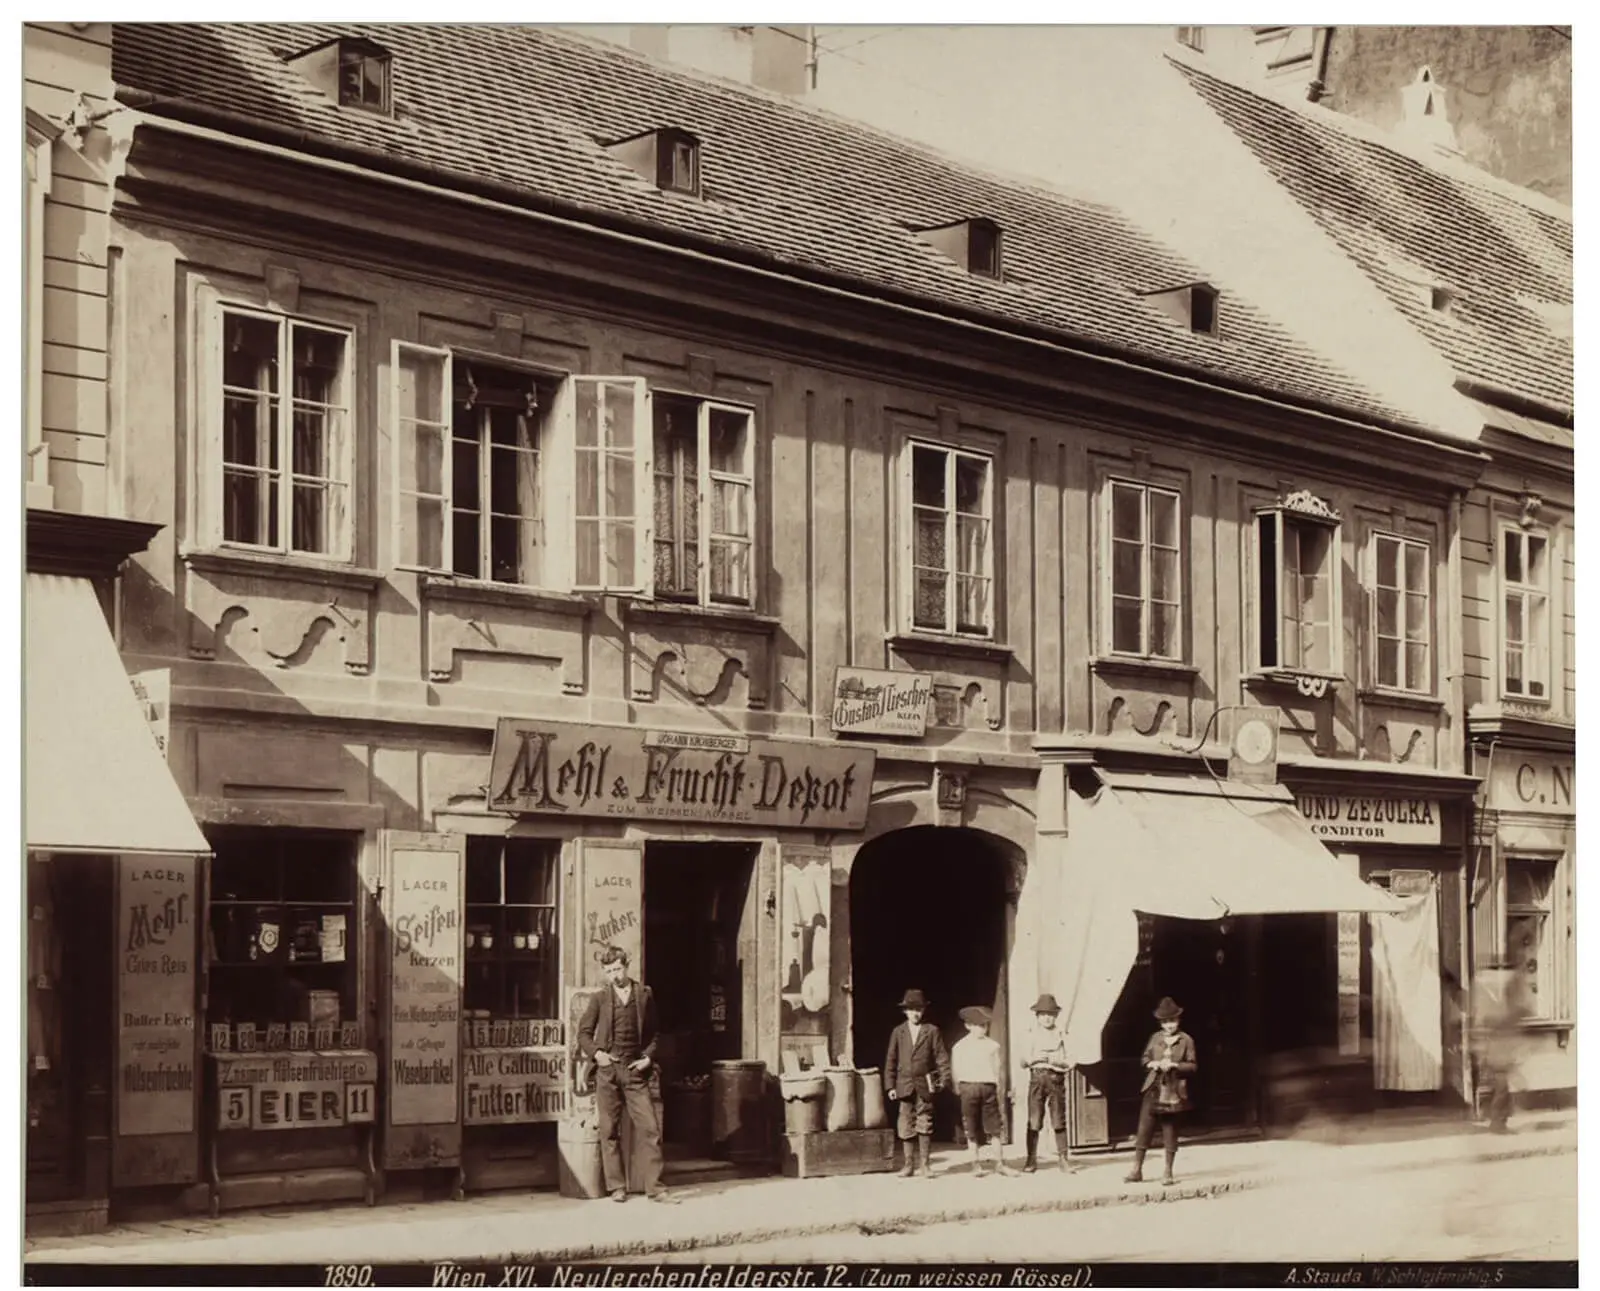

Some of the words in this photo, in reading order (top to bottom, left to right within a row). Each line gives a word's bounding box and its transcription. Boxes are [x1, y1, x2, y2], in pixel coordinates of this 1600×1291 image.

[492, 729, 612, 812] Mehl
[611, 775, 630, 800] &
[607, 804, 636, 815] ZUM
[1297, 794, 1341, 821] UND
[1346, 796, 1435, 826] ZEZULKA
[1311, 823, 1385, 838] CONDITOR
[131, 869, 185, 883] LAGER
[402, 879, 448, 892] LAGER
[594, 876, 632, 888] LAGER
[409, 951, 455, 968] Kerzen
[465, 1054, 494, 1077] Alle
[227, 1092, 244, 1120] 5
[260, 1090, 342, 1124] EIER
[351, 1088, 369, 1114] 11
